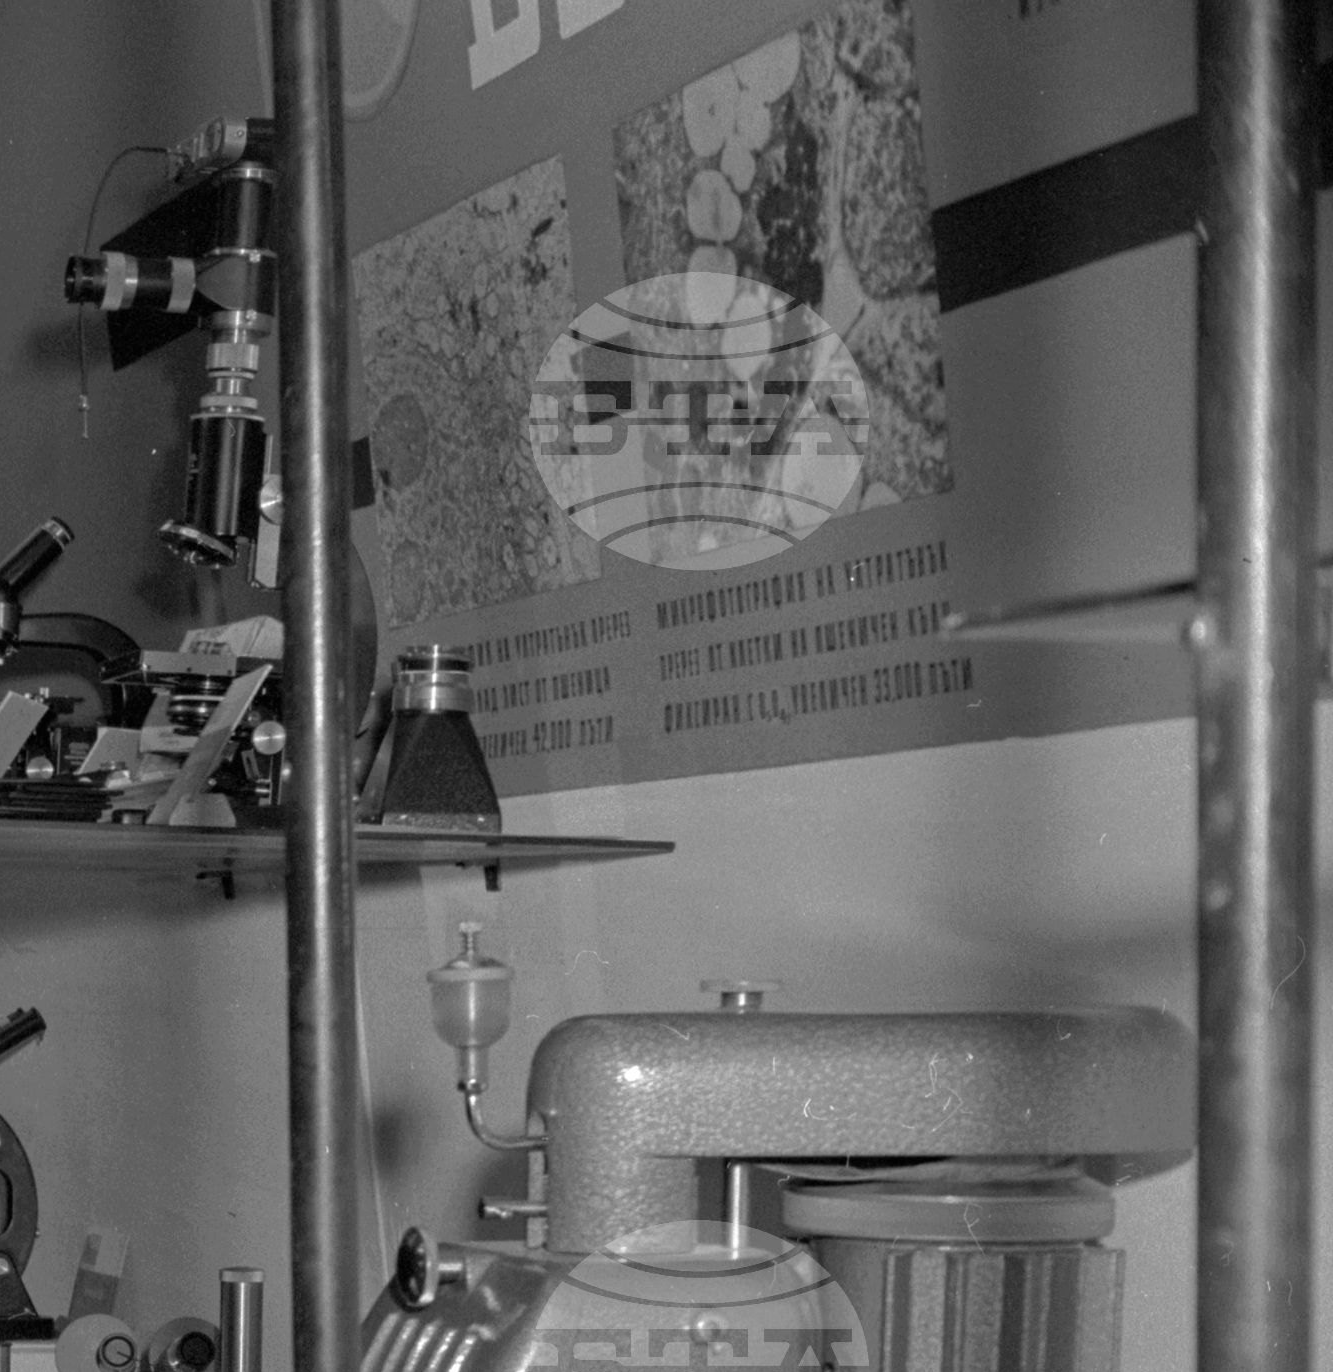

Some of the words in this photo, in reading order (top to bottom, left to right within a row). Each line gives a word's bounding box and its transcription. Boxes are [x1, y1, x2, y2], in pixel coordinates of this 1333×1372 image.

[815, 564, 836, 599] НА
[496, 637, 511, 663] НА
[591, 610, 631, 645] ПРЕРЕЗ
[659, 647, 701, 682] ПРЕРЕЗ
[708, 642, 723, 673] ОТ
[729, 632, 783, 669] КЛЕТКИ
[790, 627, 808, 660] НА
[815, 609, 899, 654] ПШЕНИЧЕН
[535, 677, 548, 704] ОТ
[552, 665, 612, 701] ПШЕНИЦА
[664, 694, 741, 734] ФИКСИРАН
[790, 673, 868, 716] УВЕЛИЧЕН
[928, 657, 973, 696] ПЪТИ
[478, 729, 527, 759] ВЕЛИЧЕН
[579, 714, 613, 746] ПЪТИ
